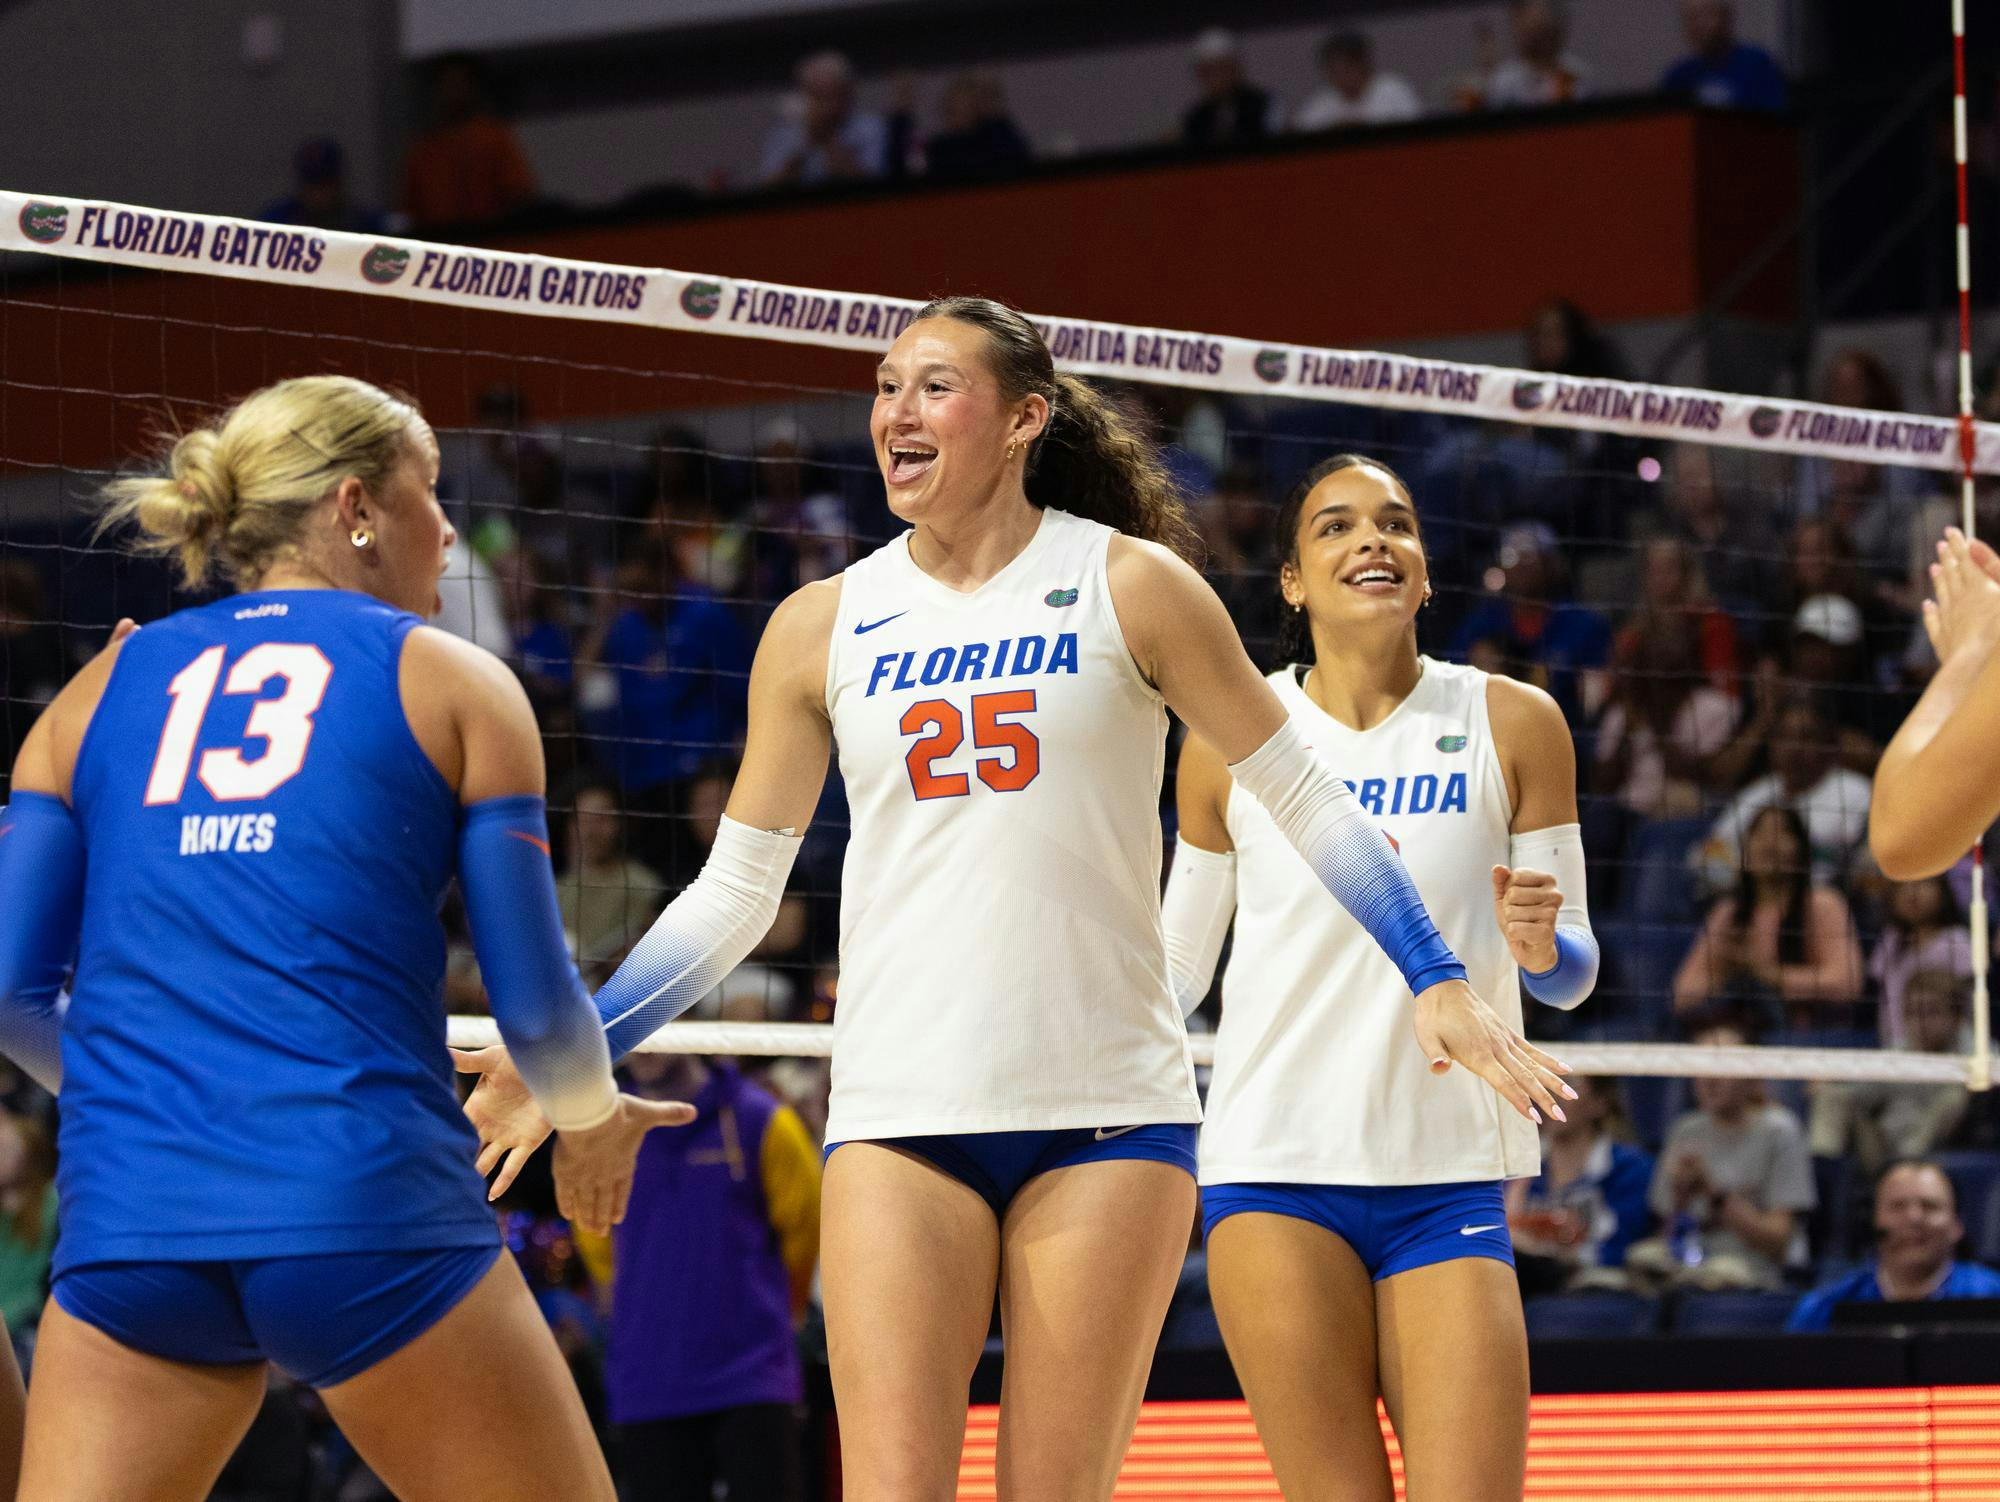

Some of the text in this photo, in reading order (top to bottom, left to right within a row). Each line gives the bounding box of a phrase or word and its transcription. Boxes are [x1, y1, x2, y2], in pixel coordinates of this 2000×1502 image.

[75, 206, 326, 274] FLORIDA GATORS
[413, 251, 648, 310] FLORIDA GATORS
[729, 287, 913, 340] FLORIDA GATO
[1033, 323, 1223, 375] ORIDA GATORS
[1300, 353, 1391, 392] FLORIDA
[864, 633, 1078, 697] FLORIDA
[143, 642, 333, 806] 13
[899, 689, 1040, 801] 25
[1342, 772, 1466, 815] RIDA
[180, 813, 276, 856] HAYES
